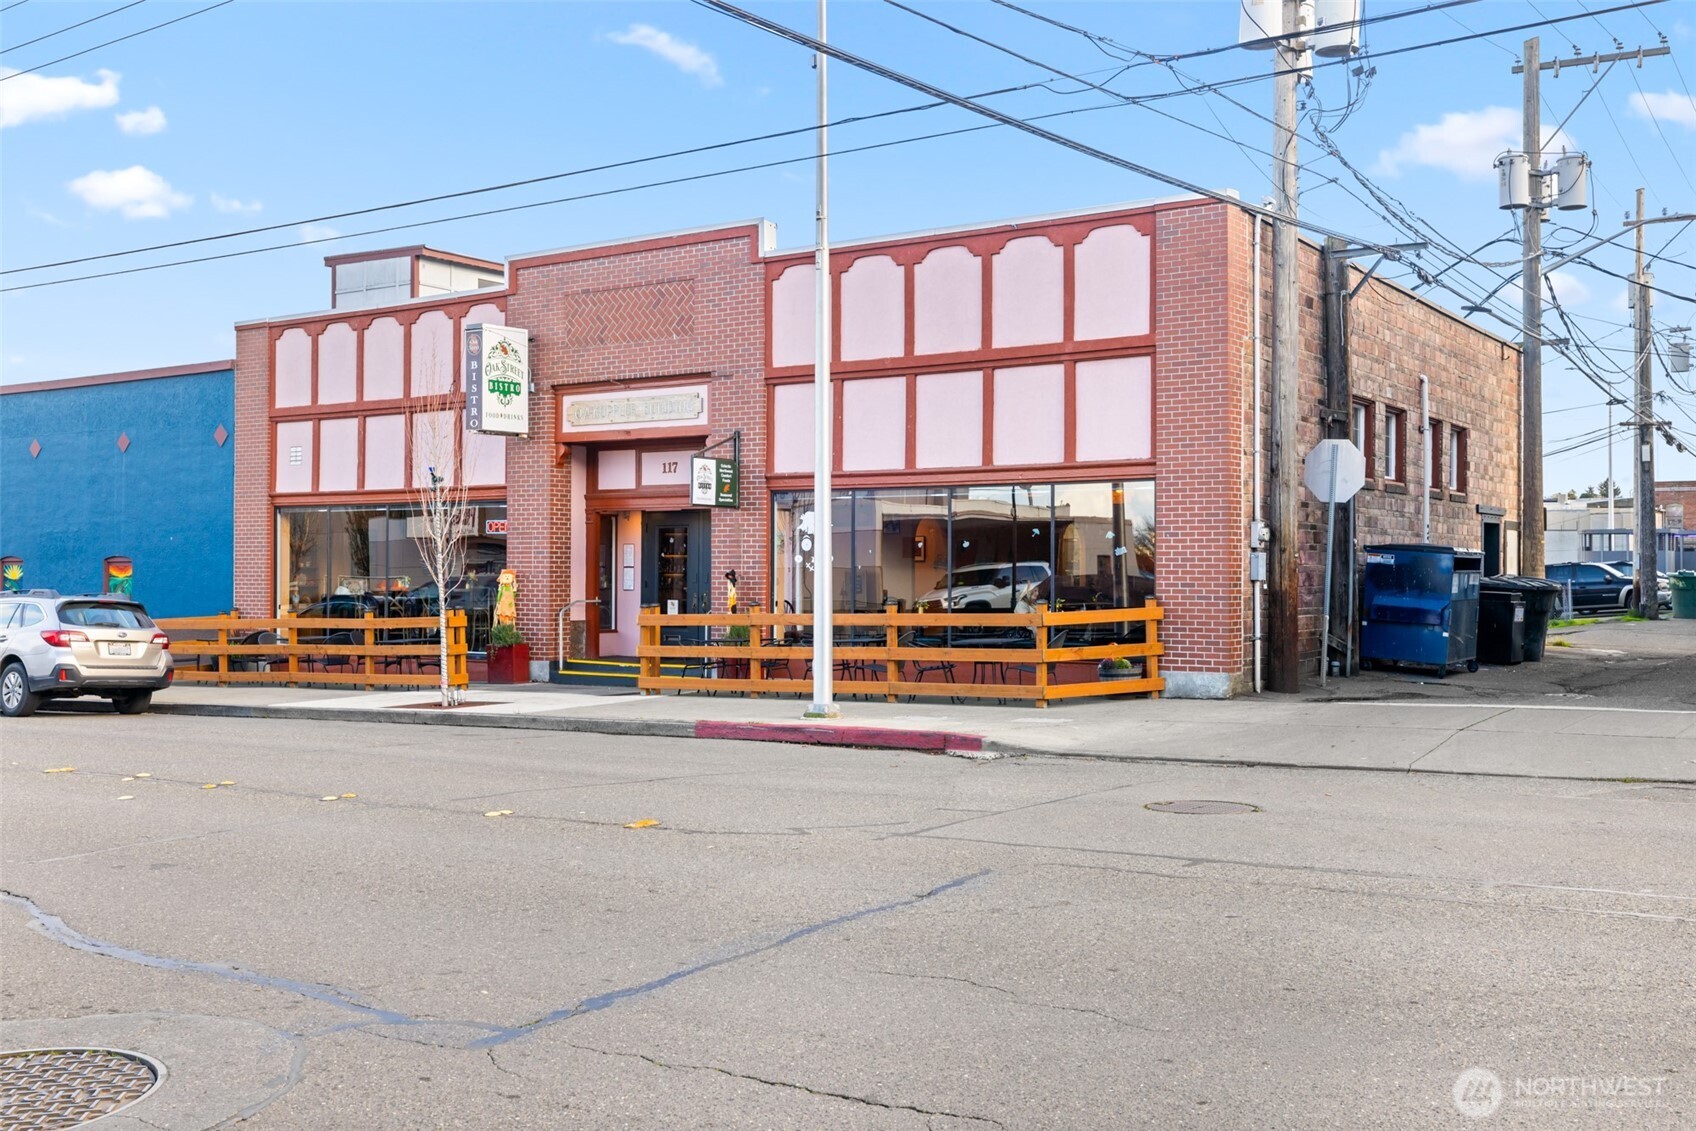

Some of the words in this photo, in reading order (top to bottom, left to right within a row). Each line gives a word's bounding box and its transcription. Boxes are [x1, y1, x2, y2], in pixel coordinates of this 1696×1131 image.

[484, 361, 501, 377] OAK
[500, 360, 525, 380] STREET
[469, 361, 479, 427] BISTRO
[488, 381, 521, 393] BISTRO
[662, 462, 678, 473] 117
